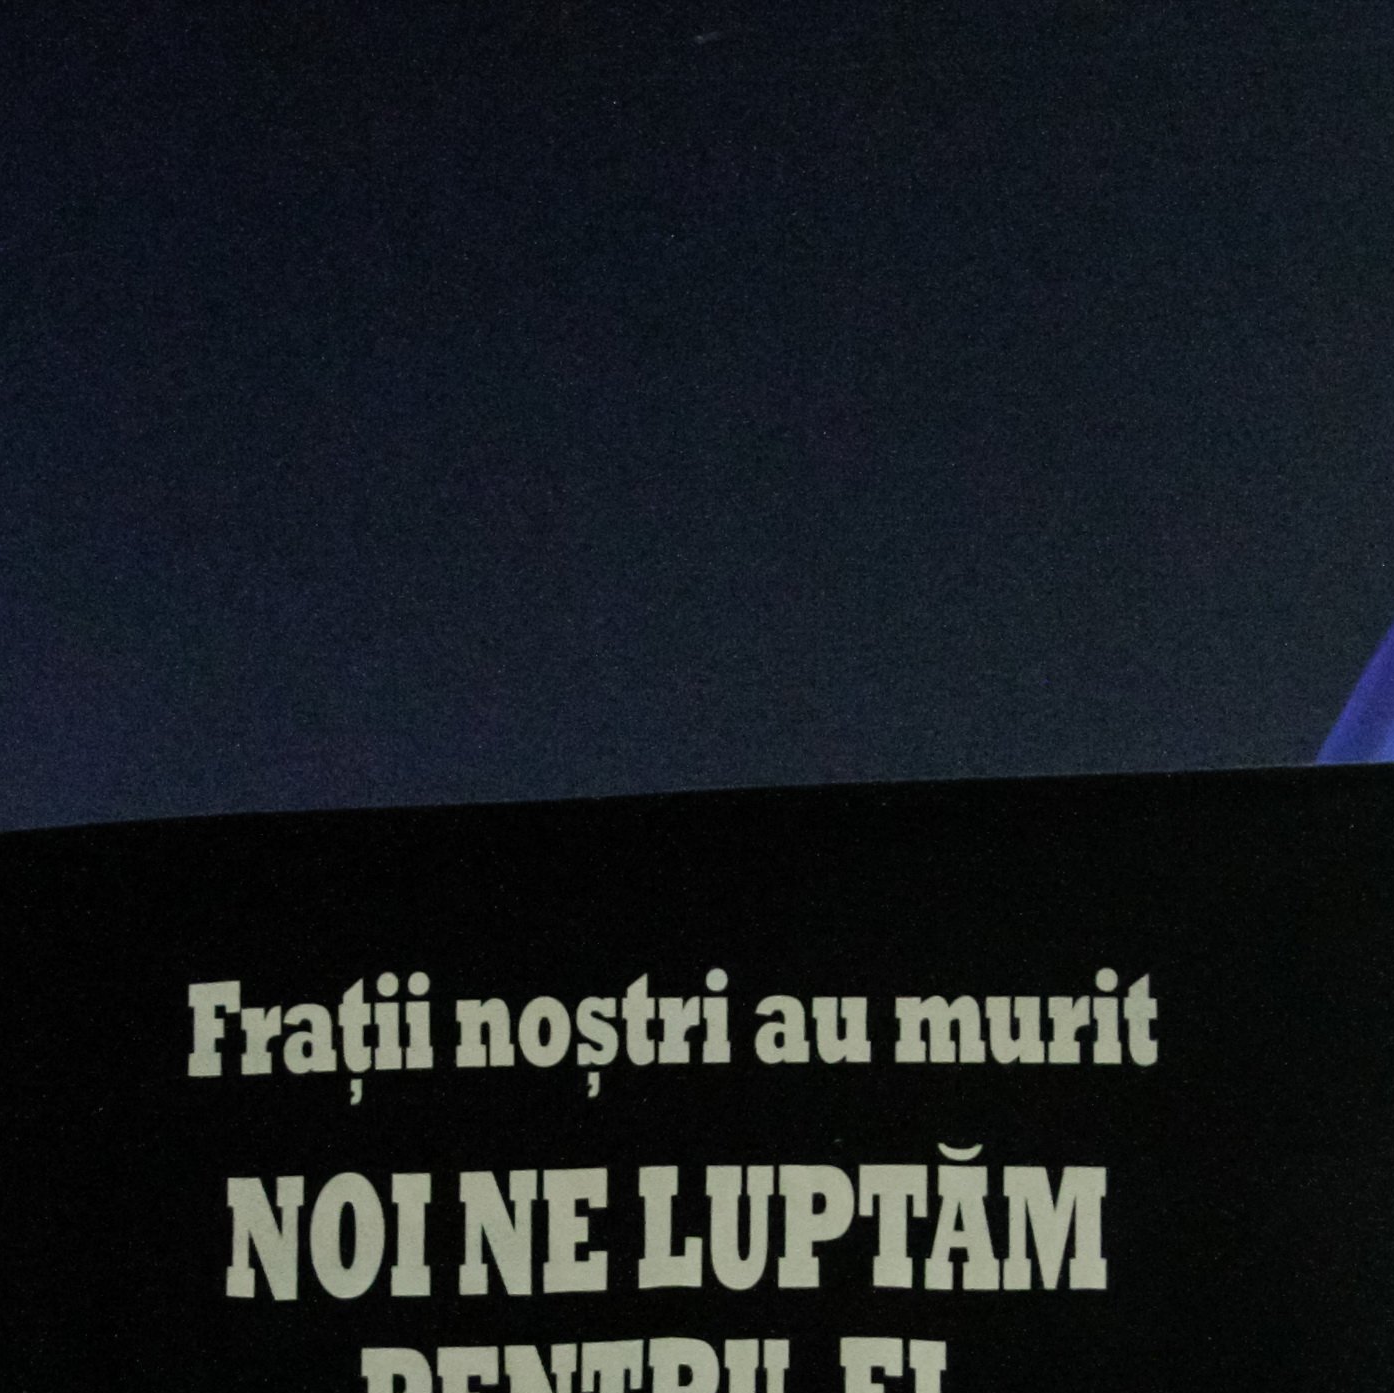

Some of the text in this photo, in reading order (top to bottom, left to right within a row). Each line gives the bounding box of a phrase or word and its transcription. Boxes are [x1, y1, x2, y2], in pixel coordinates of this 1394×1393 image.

[188, 969, 1158, 1104] Frații noștri au murit
[226, 1143, 1107, 1301] NOI NE LUPTĂM
